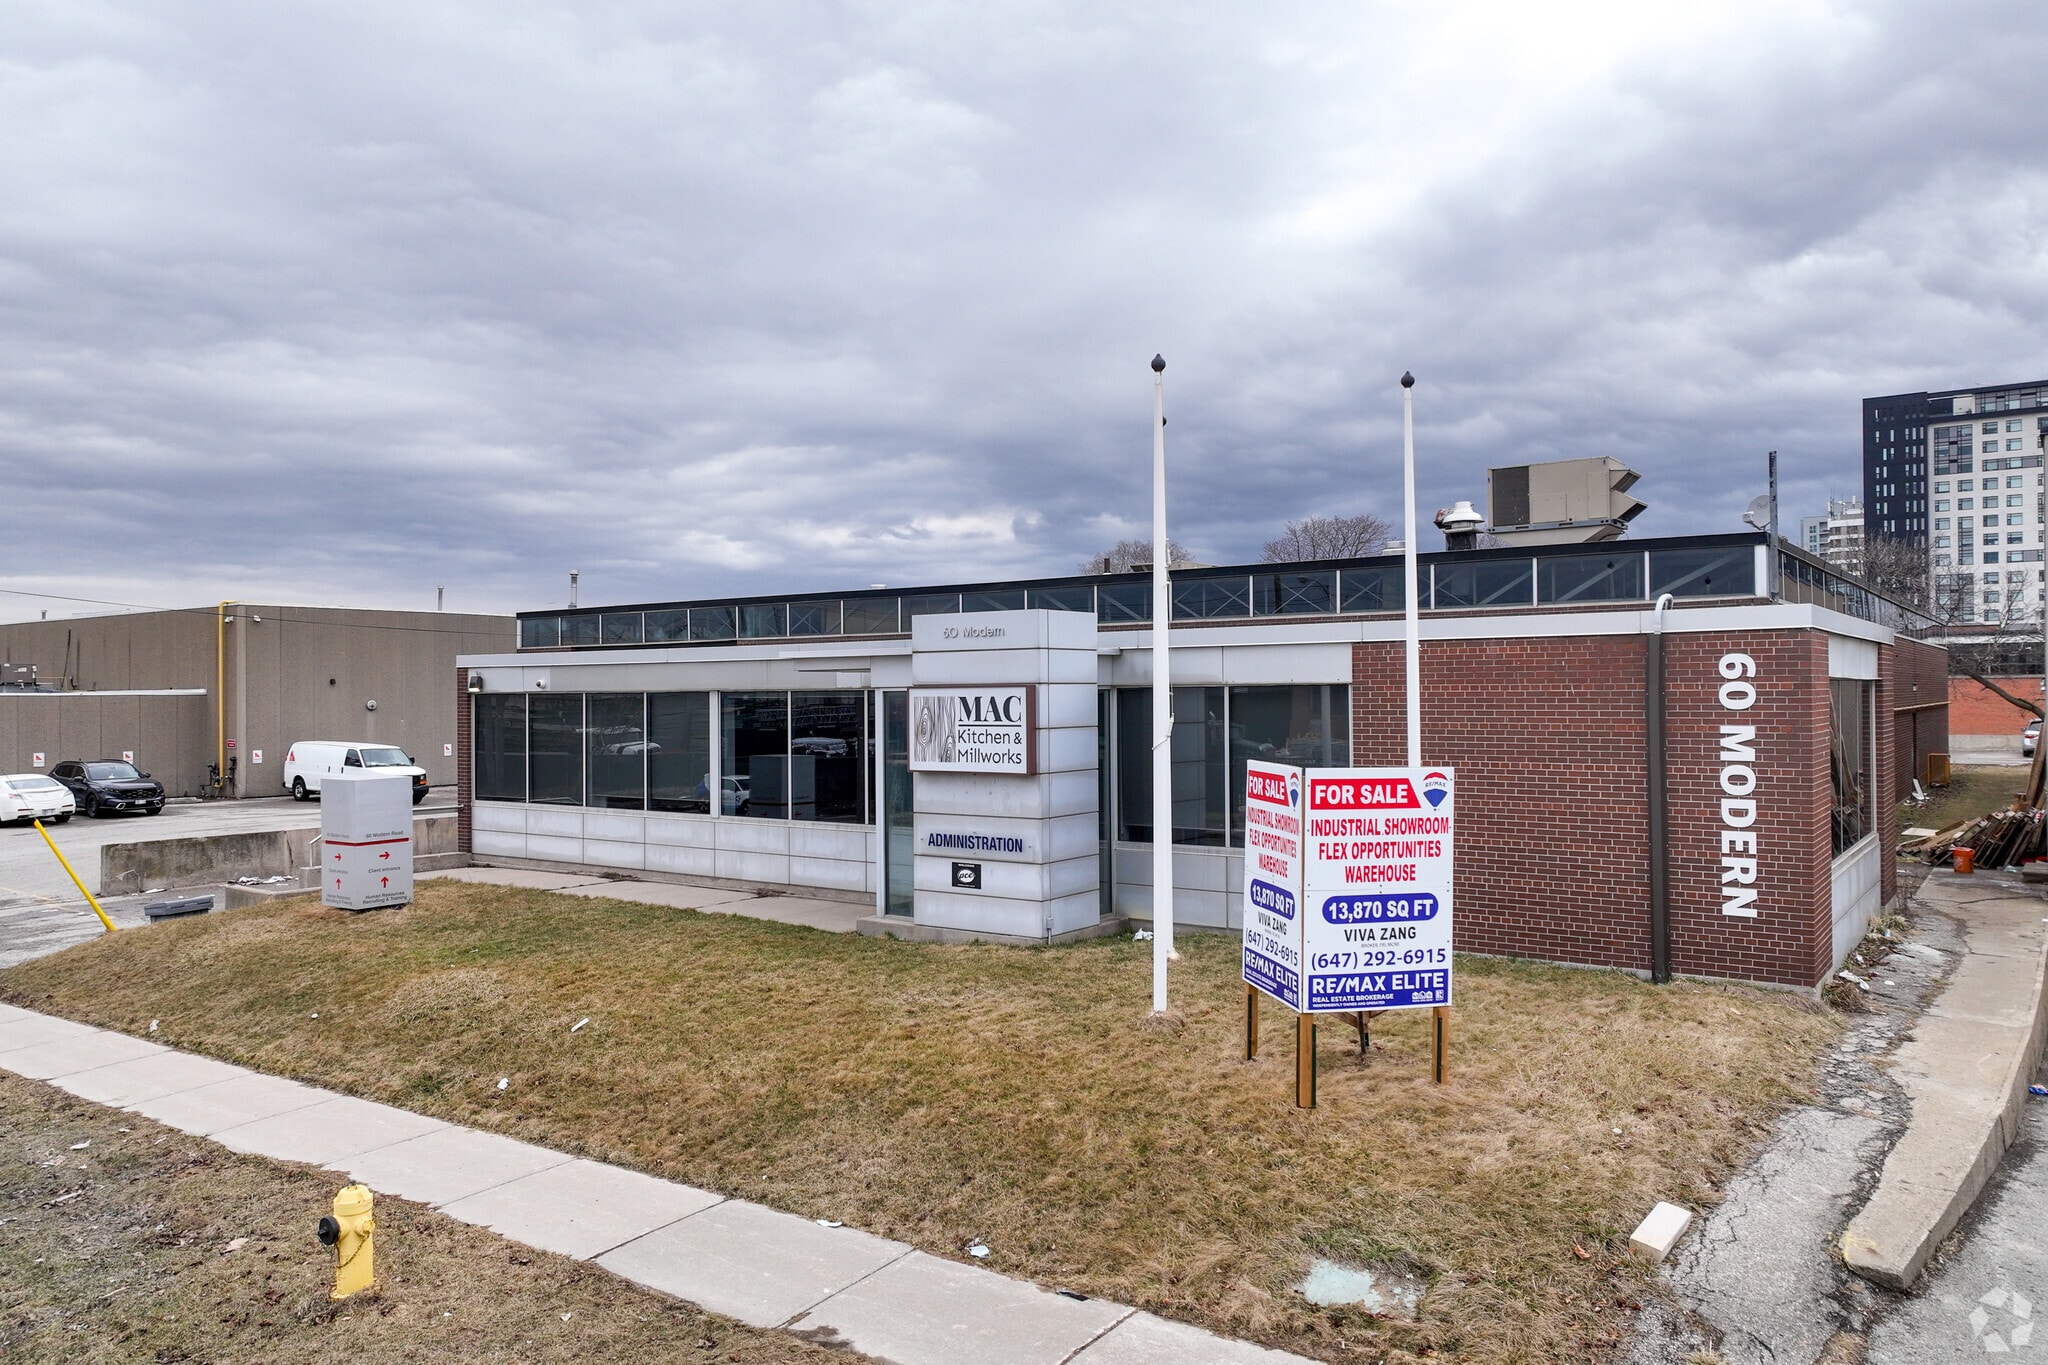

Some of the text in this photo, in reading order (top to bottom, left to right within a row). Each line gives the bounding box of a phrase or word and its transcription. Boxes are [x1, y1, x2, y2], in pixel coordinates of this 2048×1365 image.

[943, 626, 1005, 639] 60 Modern
[958, 695, 1022, 722] MAC
[957, 728, 1022, 745] Kitchen &
[957, 747, 1022, 765] Millworks
[1248, 775, 1285, 800] FOR SALE
[1315, 784, 1408, 805] FOR SALE
[1718, 653, 1757, 918] 60 MODERN
[1311, 816, 1449, 837] INDUSTRIAL SHOWROOM
[928, 832, 1024, 853] ADMINISTRATION
[1249, 828, 1260, 847] FLEX
[1319, 840, 1441, 860] FLEX OPPORTUNITIES
[1345, 864, 1416, 883] WAREHOUSE
[1252, 884, 1294, 916] 13,870 SQ FT
[1328, 899, 1434, 923] 13,870 SQ FT
[1257, 911, 1271, 928] VIVA
[1272, 918, 1288, 936] ZANG
[1344, 926, 1416, 942] VIVA ZANG
[1245, 927, 1264, 951] (647)
[1265, 937, 1298, 967] 292-6915
[1311, 948, 1446, 972] (647) 292-6915
[1245, 949, 1275, 979] RE/MAX
[1275, 970, 1298, 993] ELITE
[1312, 972, 1445, 994] RE/MAX ELITE
[1355, 993, 1394, 1001] BROKERAGE
